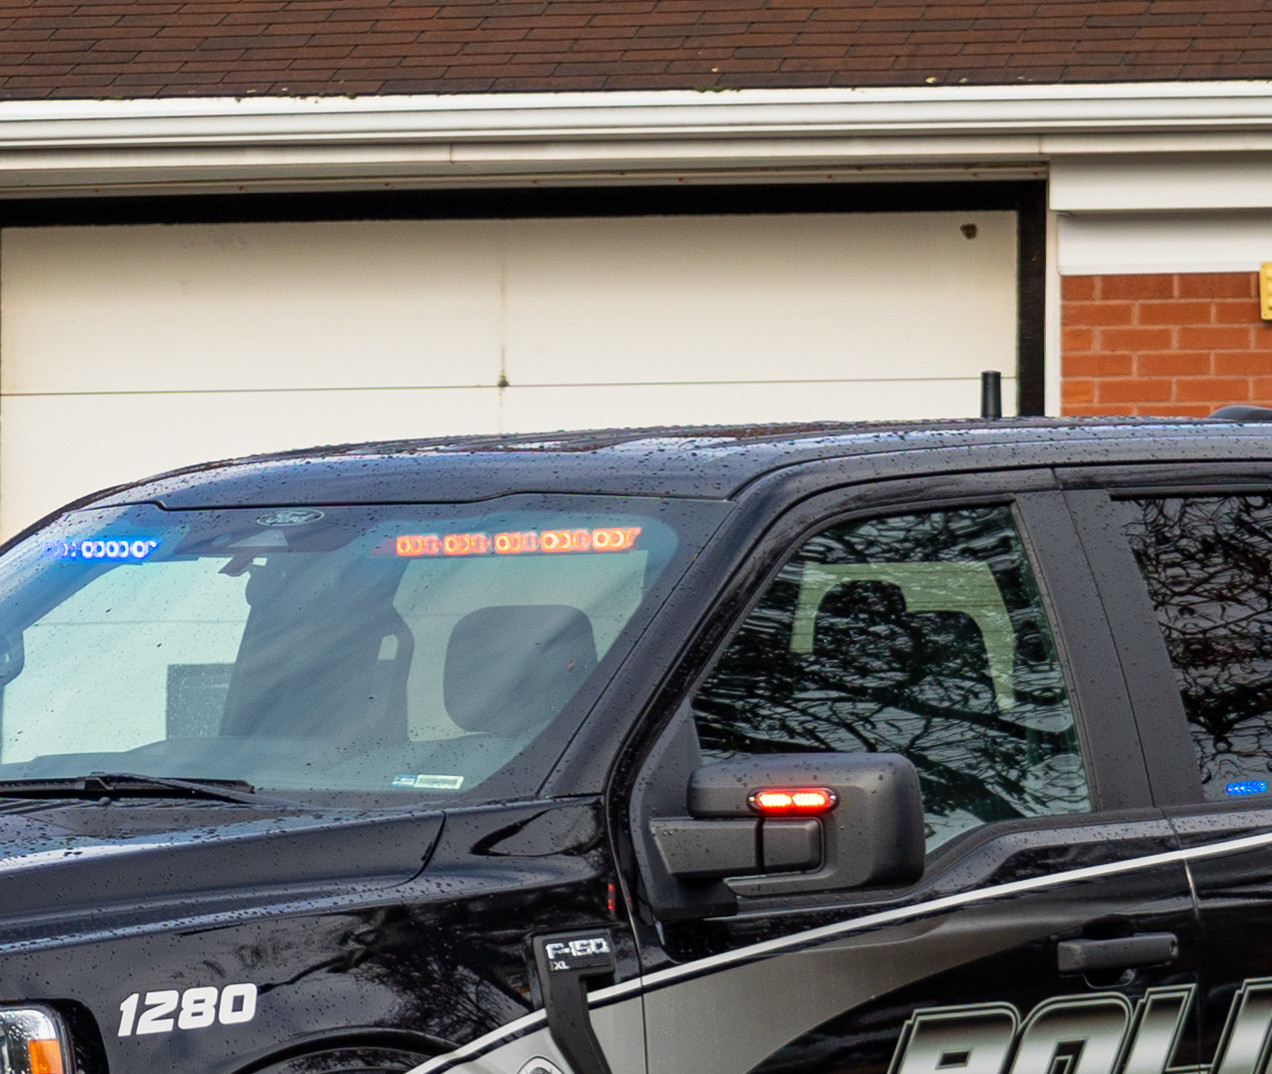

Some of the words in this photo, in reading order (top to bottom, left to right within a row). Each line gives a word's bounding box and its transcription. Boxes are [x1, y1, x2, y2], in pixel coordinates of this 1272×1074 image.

[545, 938, 610, 959] F-150
[553, 960, 570, 971] XL
[117, 982, 258, 1037] 1280
